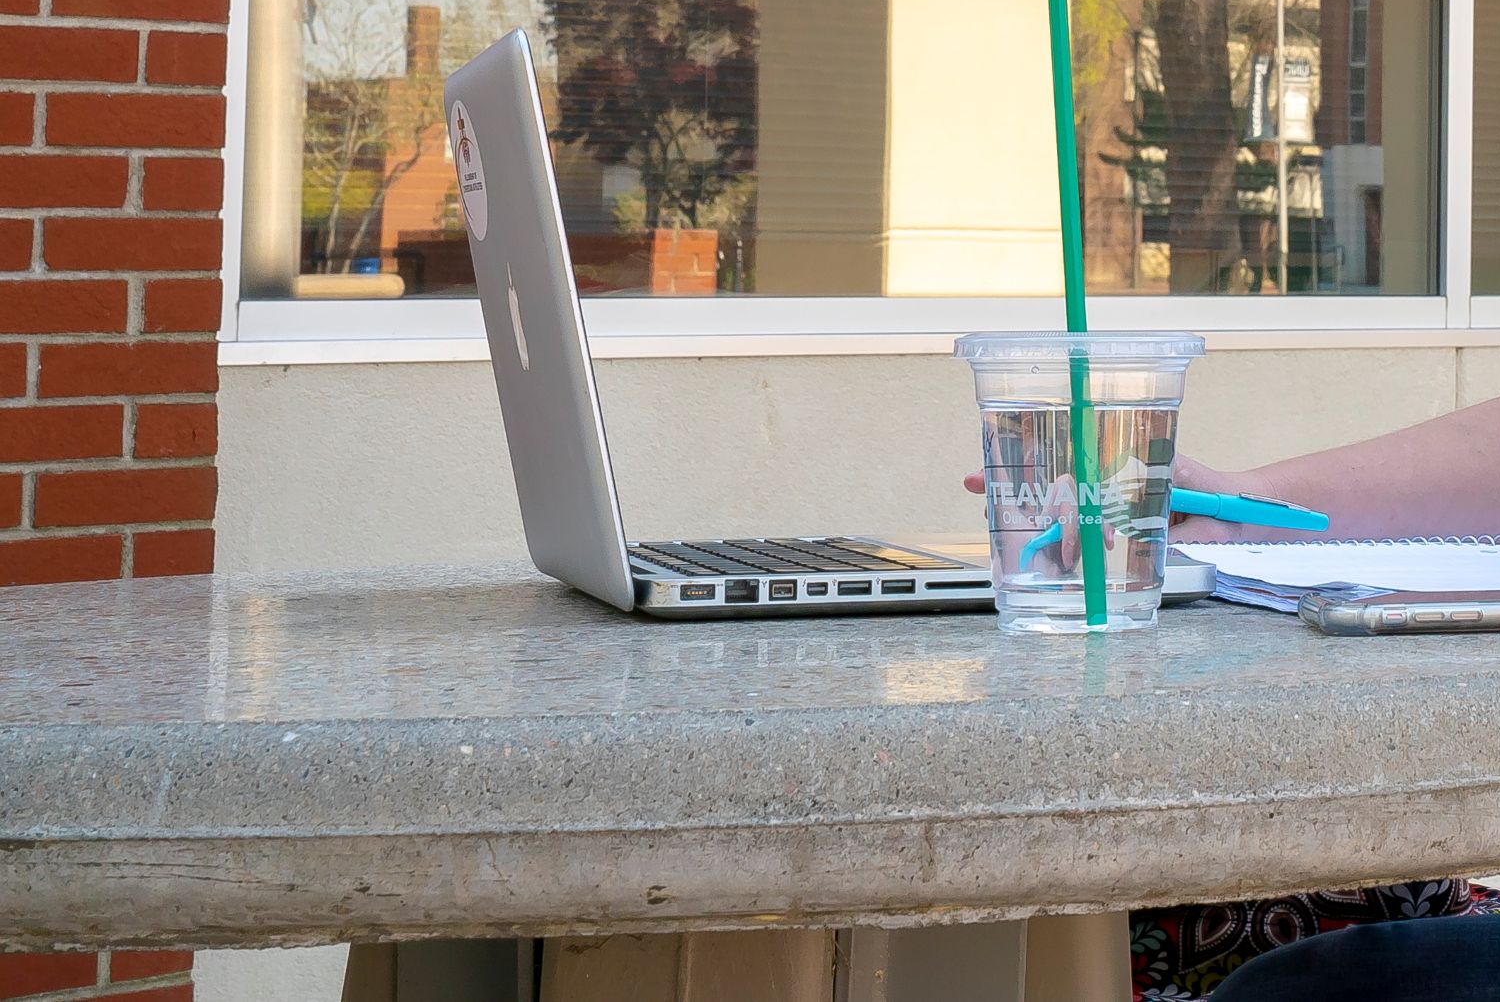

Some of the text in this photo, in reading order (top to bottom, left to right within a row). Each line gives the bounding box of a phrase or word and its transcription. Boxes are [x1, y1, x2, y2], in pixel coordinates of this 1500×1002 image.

[990, 481, 1125, 506] TEAVANA
[1002, 510, 1104, 528] Our cup of tea
